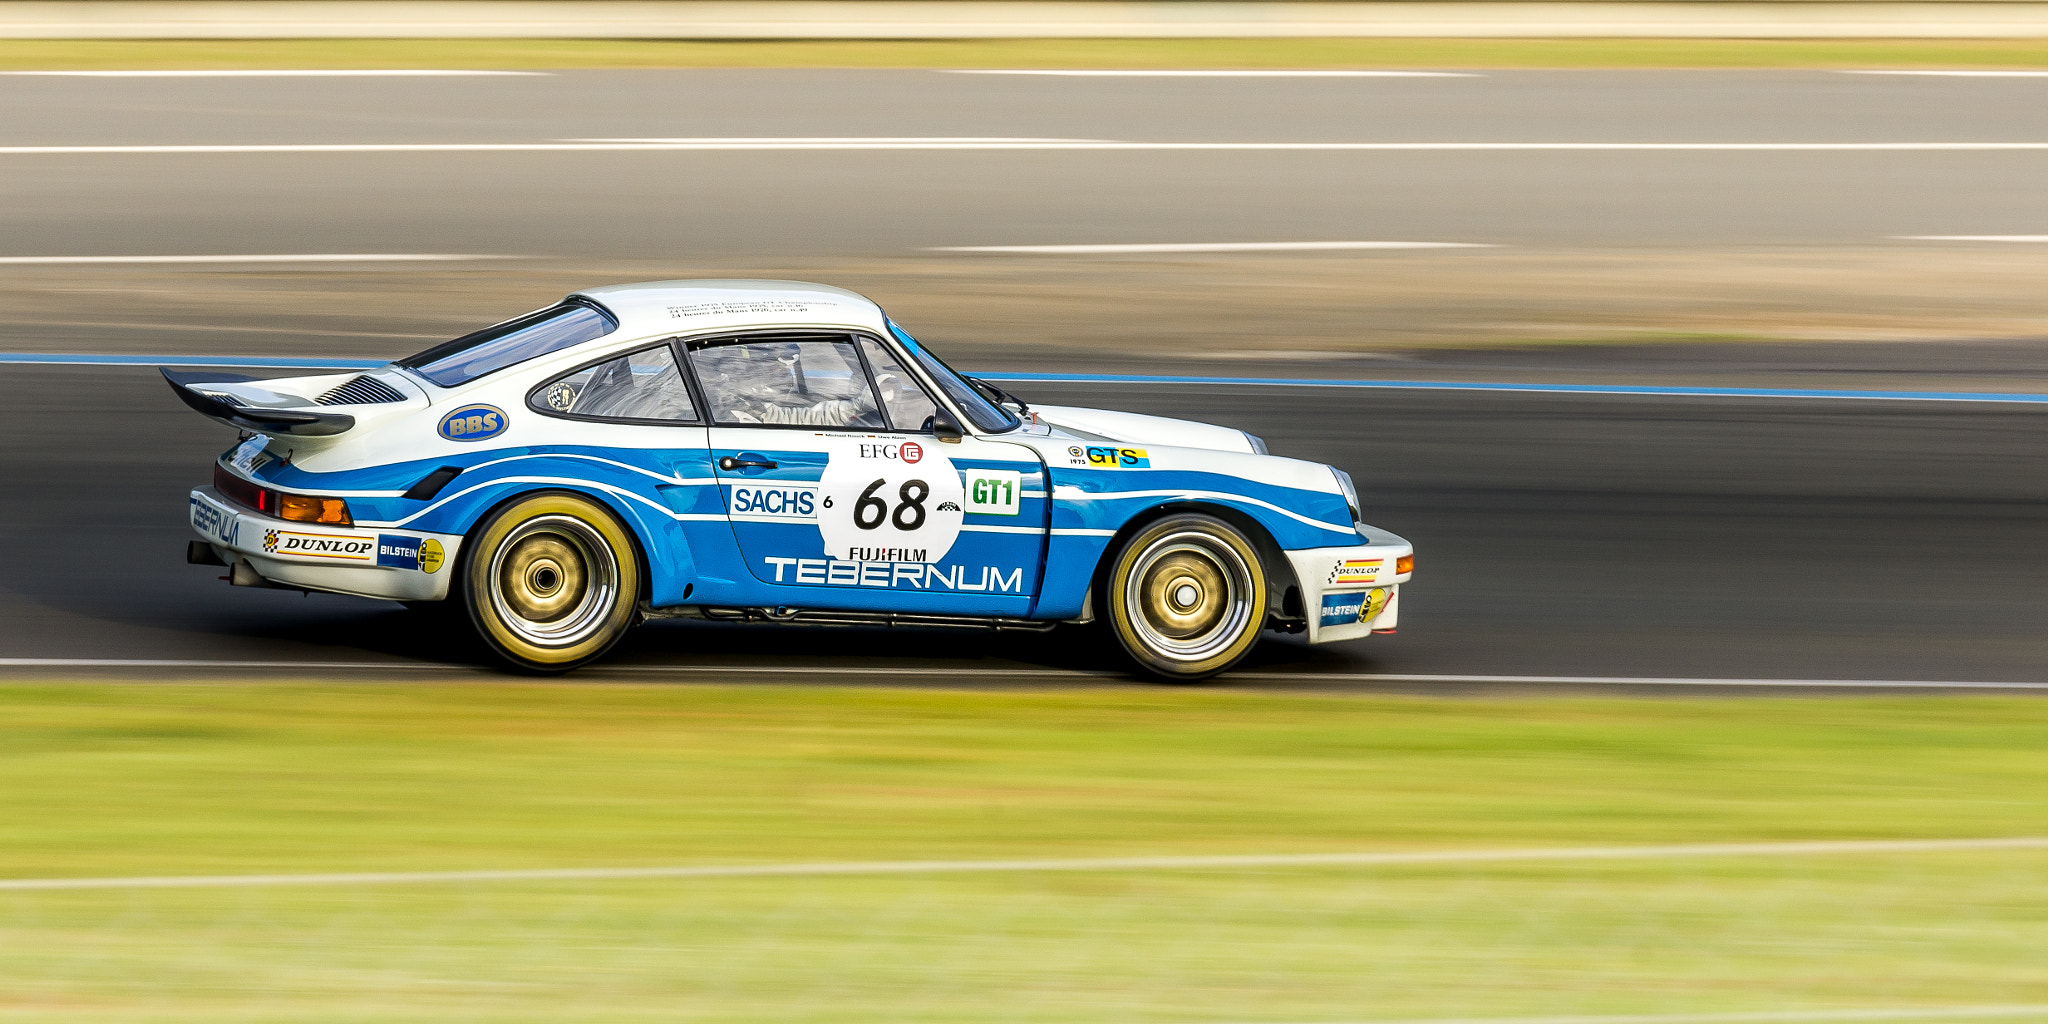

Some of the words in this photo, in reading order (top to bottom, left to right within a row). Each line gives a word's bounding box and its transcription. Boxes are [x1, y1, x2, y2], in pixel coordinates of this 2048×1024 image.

[449, 412, 498, 436] BBS
[859, 444, 898, 459] EFG
[1086, 447, 1139, 465] GTS
[972, 478, 1013, 505] GT1
[734, 488, 815, 515] SACHS
[823, 495, 834, 508] 6
[853, 478, 930, 531] 68
[285, 537, 373, 554] DUNLOP
[380, 545, 418, 558] BILSTEIN
[849, 547, 927, 562] FUJIFILM
[764, 556, 1023, 593] TEBERNUM
[1338, 567, 1380, 575] DUNLOP
[1321, 604, 1361, 617] BILSTEIN
